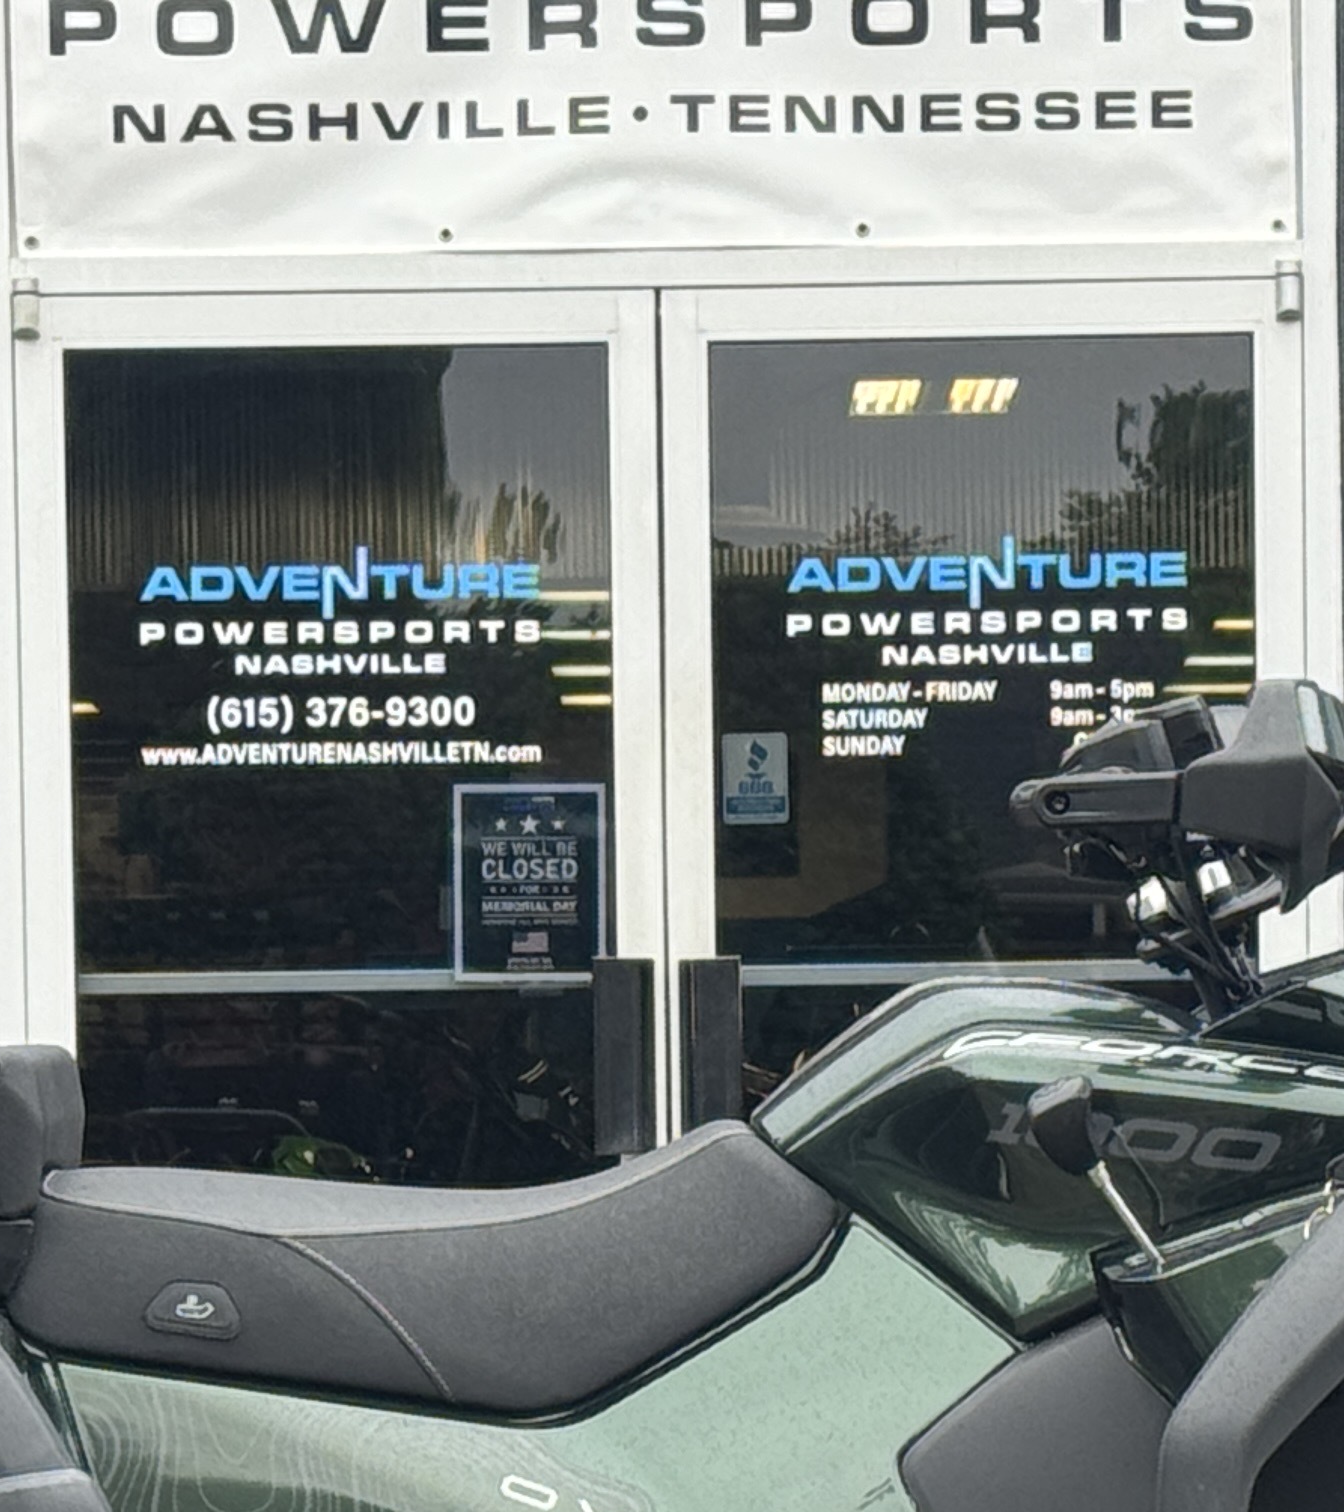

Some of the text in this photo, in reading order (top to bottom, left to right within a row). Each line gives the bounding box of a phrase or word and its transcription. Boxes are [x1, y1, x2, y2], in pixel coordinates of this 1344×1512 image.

[113, 90, 1193, 143] NASHVILLE TENNESSEE
[140, 546, 540, 619] ADVENTURE
[787, 534, 1188, 609] ADVENTURE
[139, 619, 541, 646] POWERSPORTS
[786, 608, 1188, 637] POWERSPORTS
[235, 653, 446, 675] NASHVILLE
[882, 641, 1093, 666] NASHVILLE
[822, 682, 911, 703] MONDAY
[925, 680, 998, 702] FRIDAY
[1050, 679, 1094, 700] 9am
[207, 695, 476, 734] (615) 376-9300
[822, 709, 928, 730] SATURDAY
[1050, 706, 1095, 727] 9am
[141, 740, 542, 766] www.ADVENTURENASHVILLETN.com
[822, 735, 906, 757] SUNDAY
[481, 840, 507, 857] WE
[511, 839, 551, 857] WILL
[481, 857, 579, 881] CLOSED
